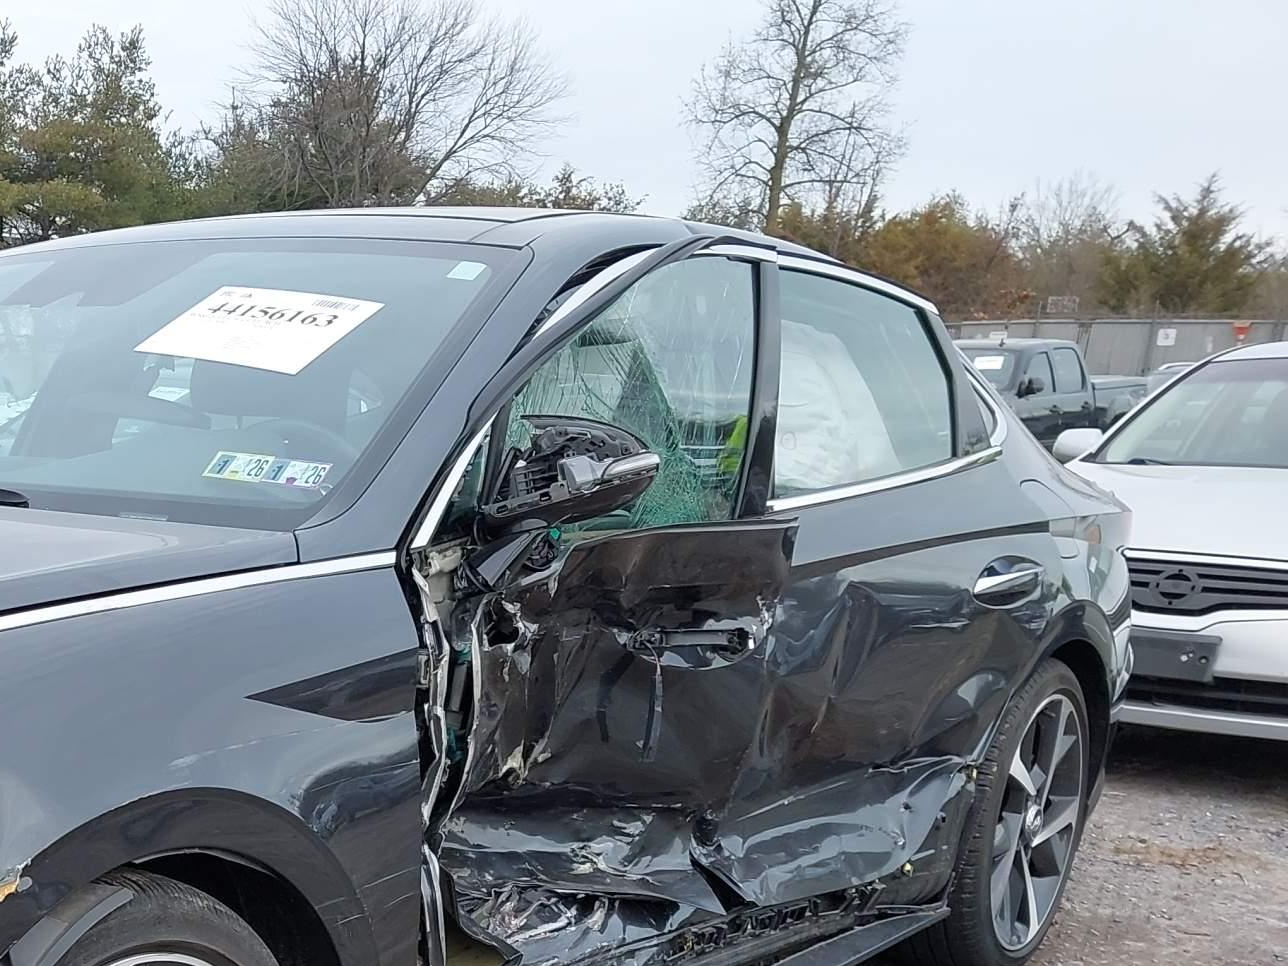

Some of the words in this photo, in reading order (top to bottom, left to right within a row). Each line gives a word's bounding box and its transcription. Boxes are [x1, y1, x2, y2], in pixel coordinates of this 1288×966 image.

[208, 302, 339, 327] 44156163
[247, 458, 269, 477] 26
[304, 465, 327, 485] 26
